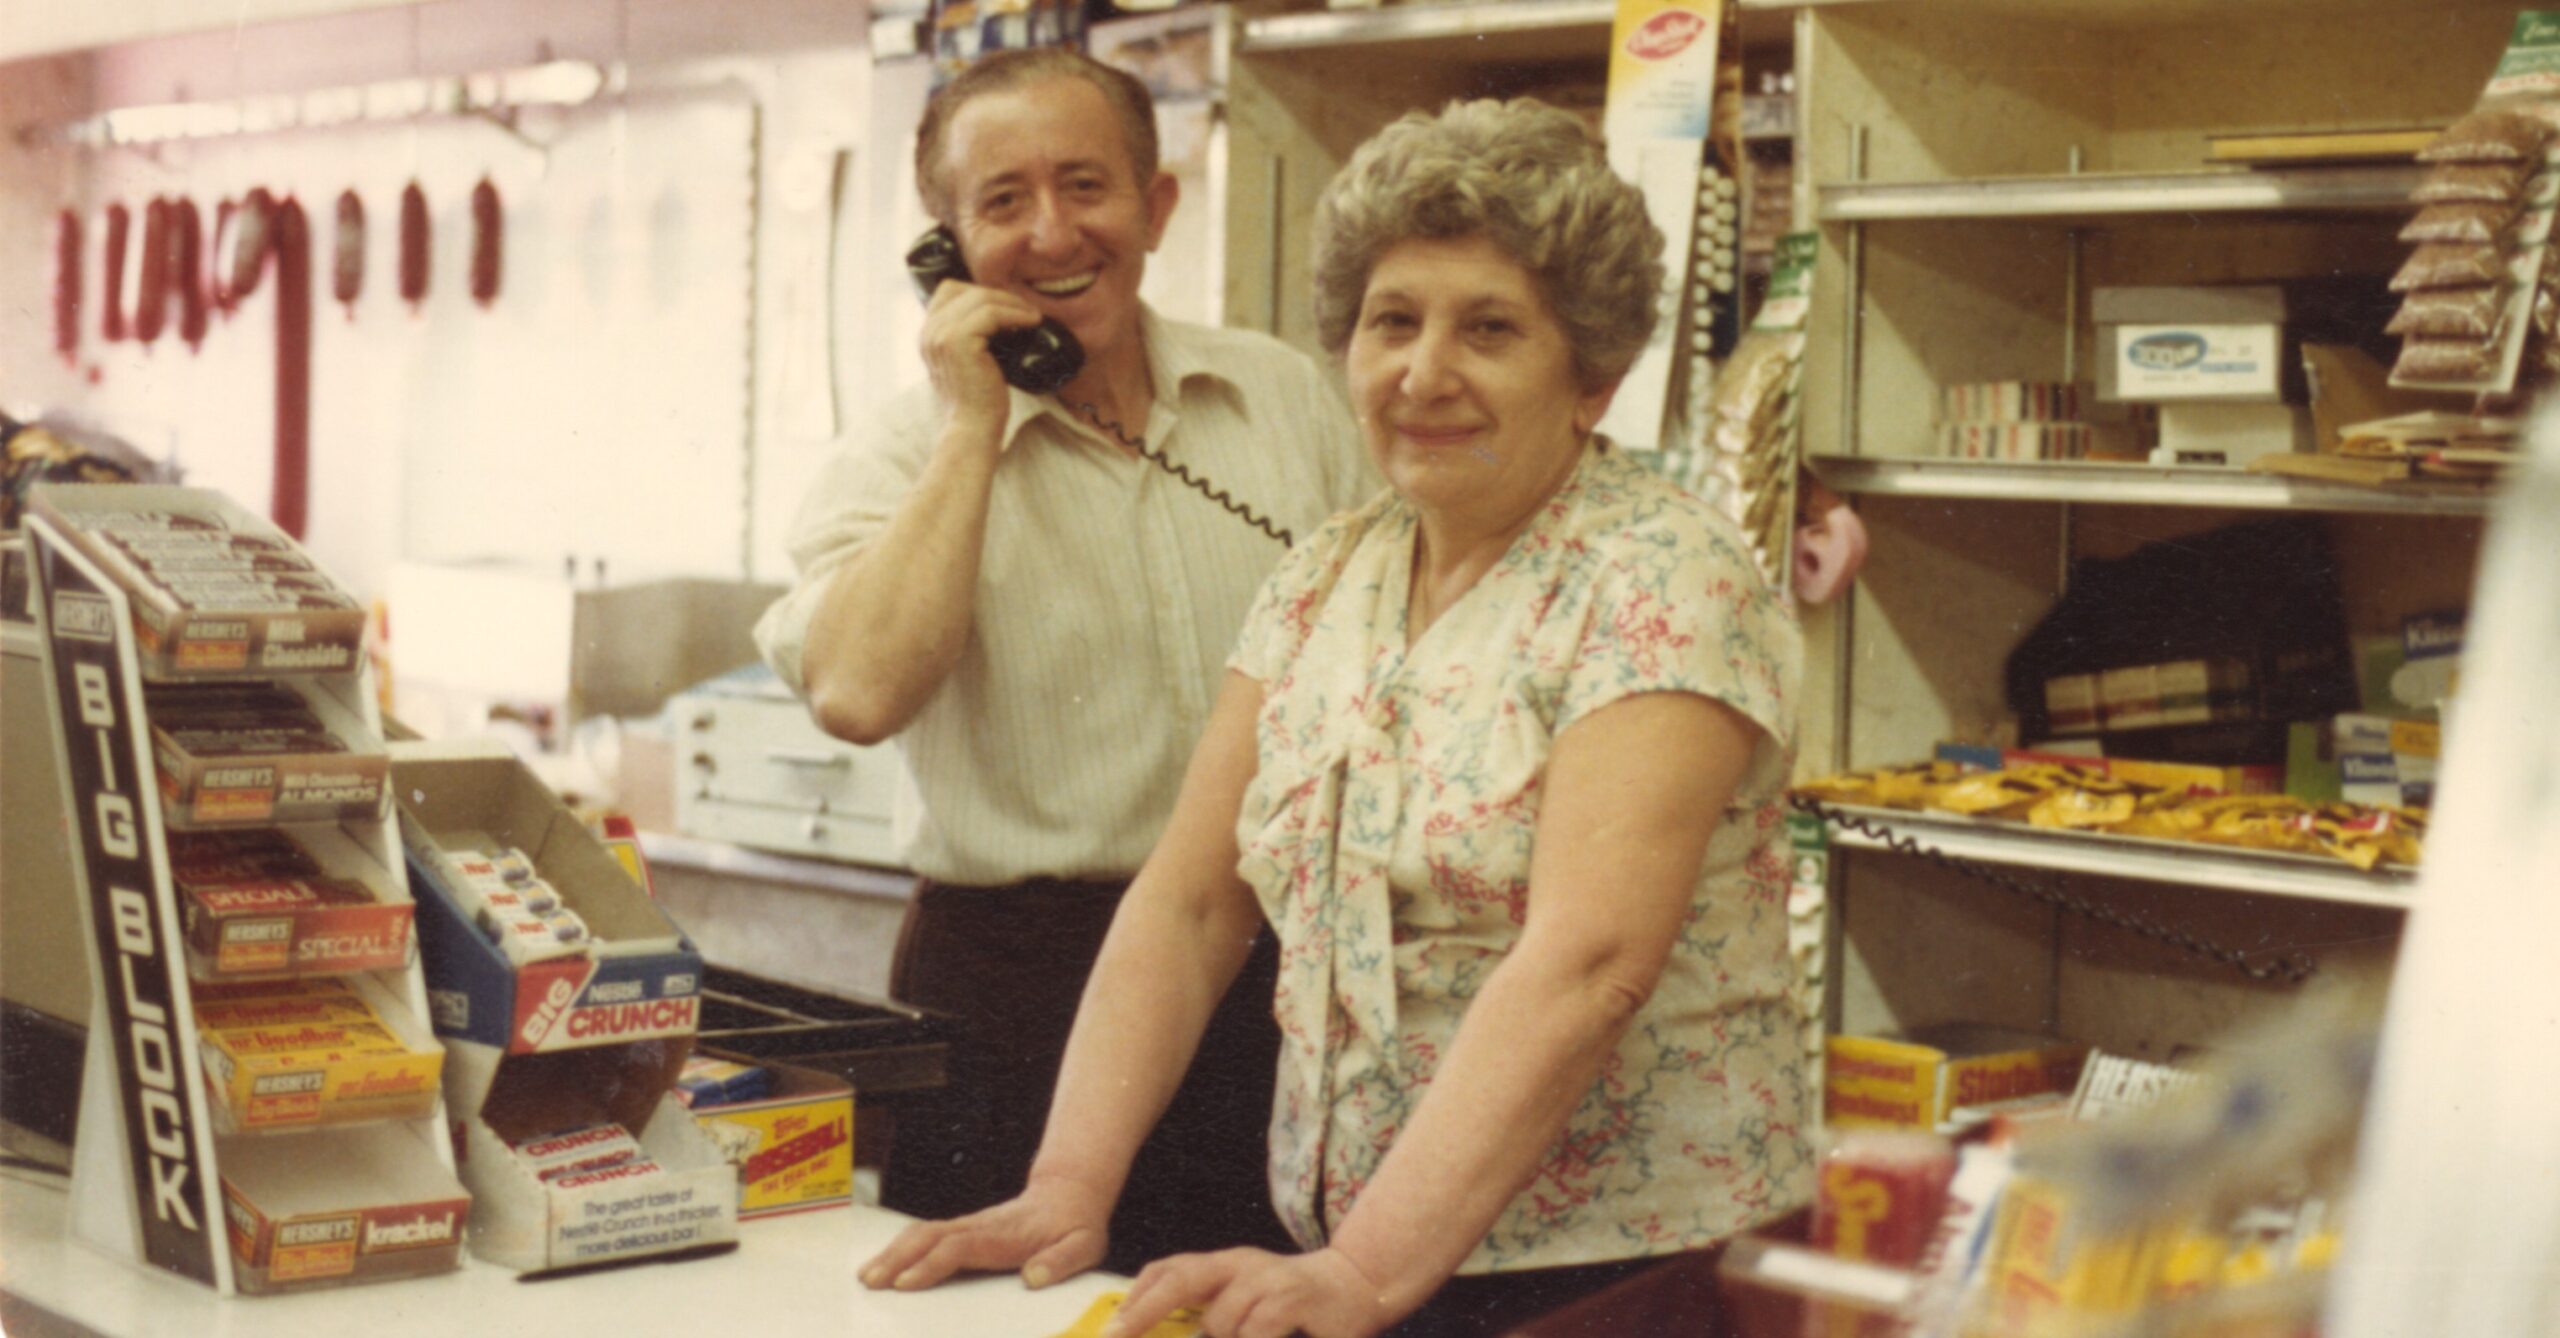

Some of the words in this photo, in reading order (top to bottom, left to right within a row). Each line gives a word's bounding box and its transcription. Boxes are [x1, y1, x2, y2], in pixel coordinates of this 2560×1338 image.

[262, 643, 349, 667] Chocolate
[279, 787, 378, 804] ALMONDS
[74, 661, 138, 859] BIG
[110, 887, 199, 1231] BLOCK
[299, 936, 388, 960] SPECIAL
[521, 977, 574, 1046] BIG
[566, 998, 694, 1039] CRUNCH
[527, 1125, 625, 1157] CRUNCH
[745, 1115, 849, 1186] BASEBALL
[557, 1162, 660, 1188] CRUNCH
[585, 1200, 607, 1216] The
[610, 1195, 645, 1216] great
[648, 1191, 677, 1207] taste
[681, 1187, 693, 1201] of
[364, 1211, 456, 1249] krackel
[603, 1215, 650, 1234] Crunch
[576, 1240, 611, 1256] more
[613, 1230, 671, 1251] delicious
